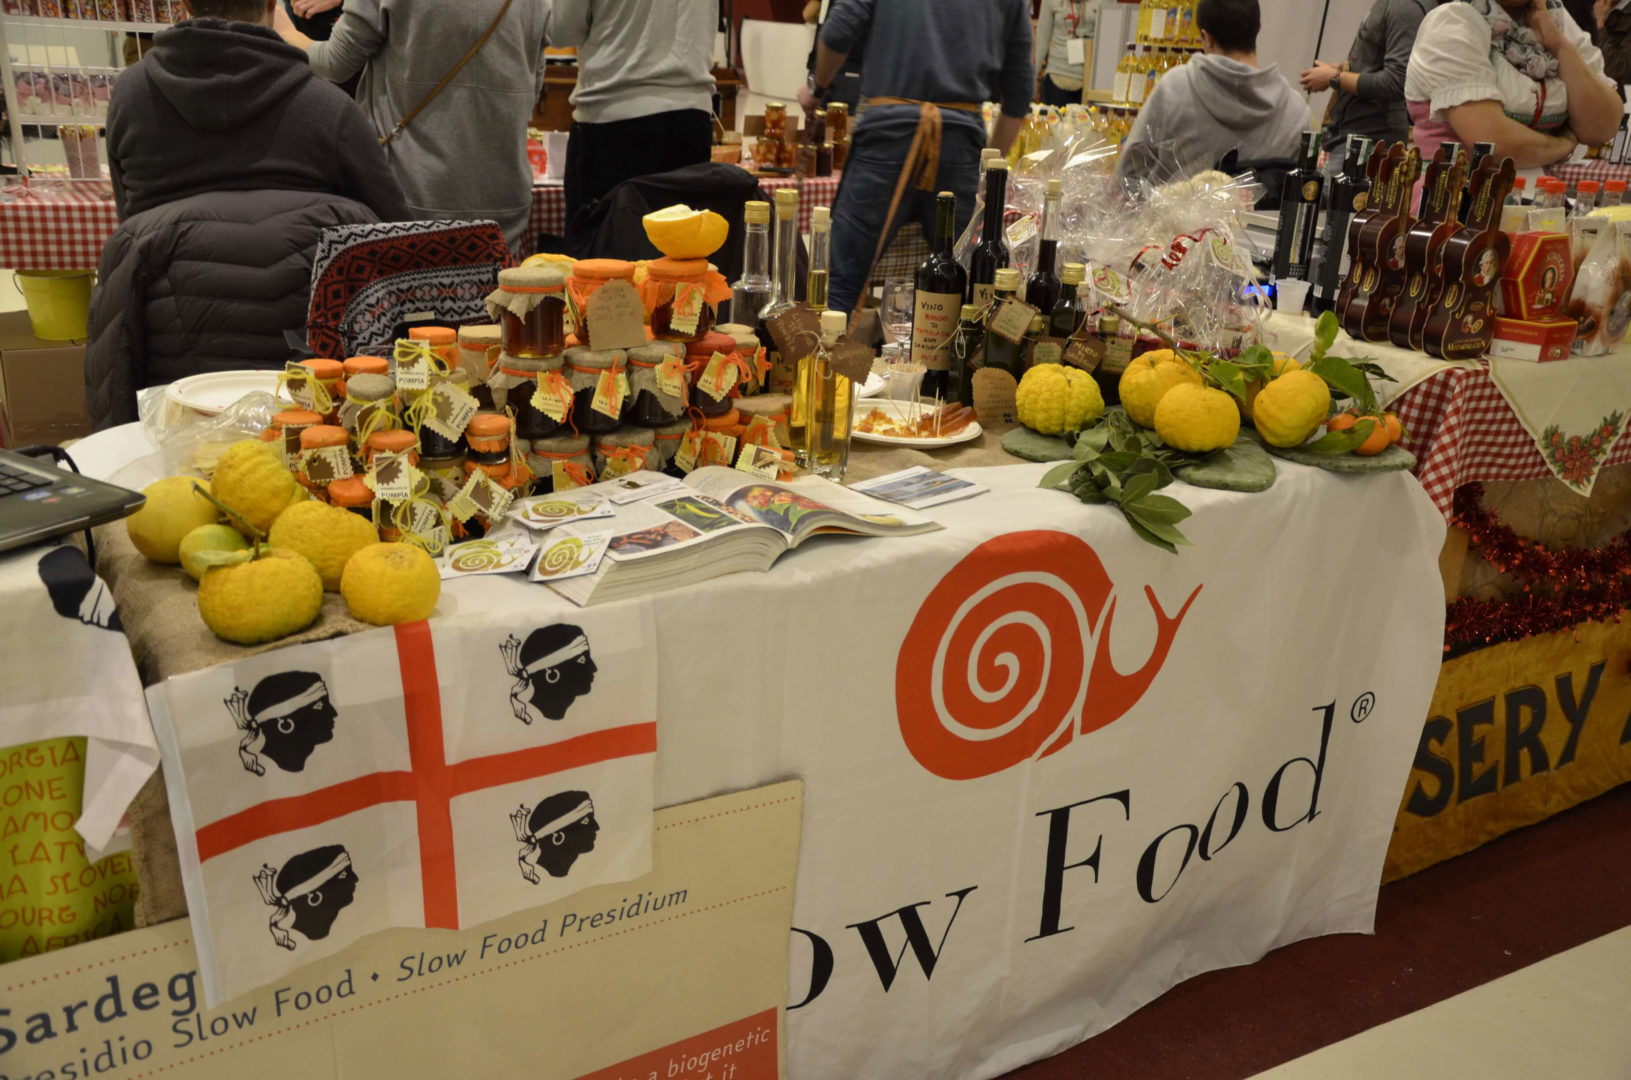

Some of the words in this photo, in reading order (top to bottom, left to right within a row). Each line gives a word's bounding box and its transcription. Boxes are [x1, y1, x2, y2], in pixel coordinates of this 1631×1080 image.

[0, 776, 68, 811] ONE
[1405, 658, 1609, 818] SERY
[1025, 699, 1337, 943] Food
[0, 969, 197, 1056] Sardeg
[171, 1005, 258, 1049] Slow
[274, 968, 356, 1018] Food
[396, 949, 468, 982] Slow
[480, 919, 549, 960] Food
[559, 888, 689, 938] Presidium
[667, 1026, 771, 1078] biogenetic
